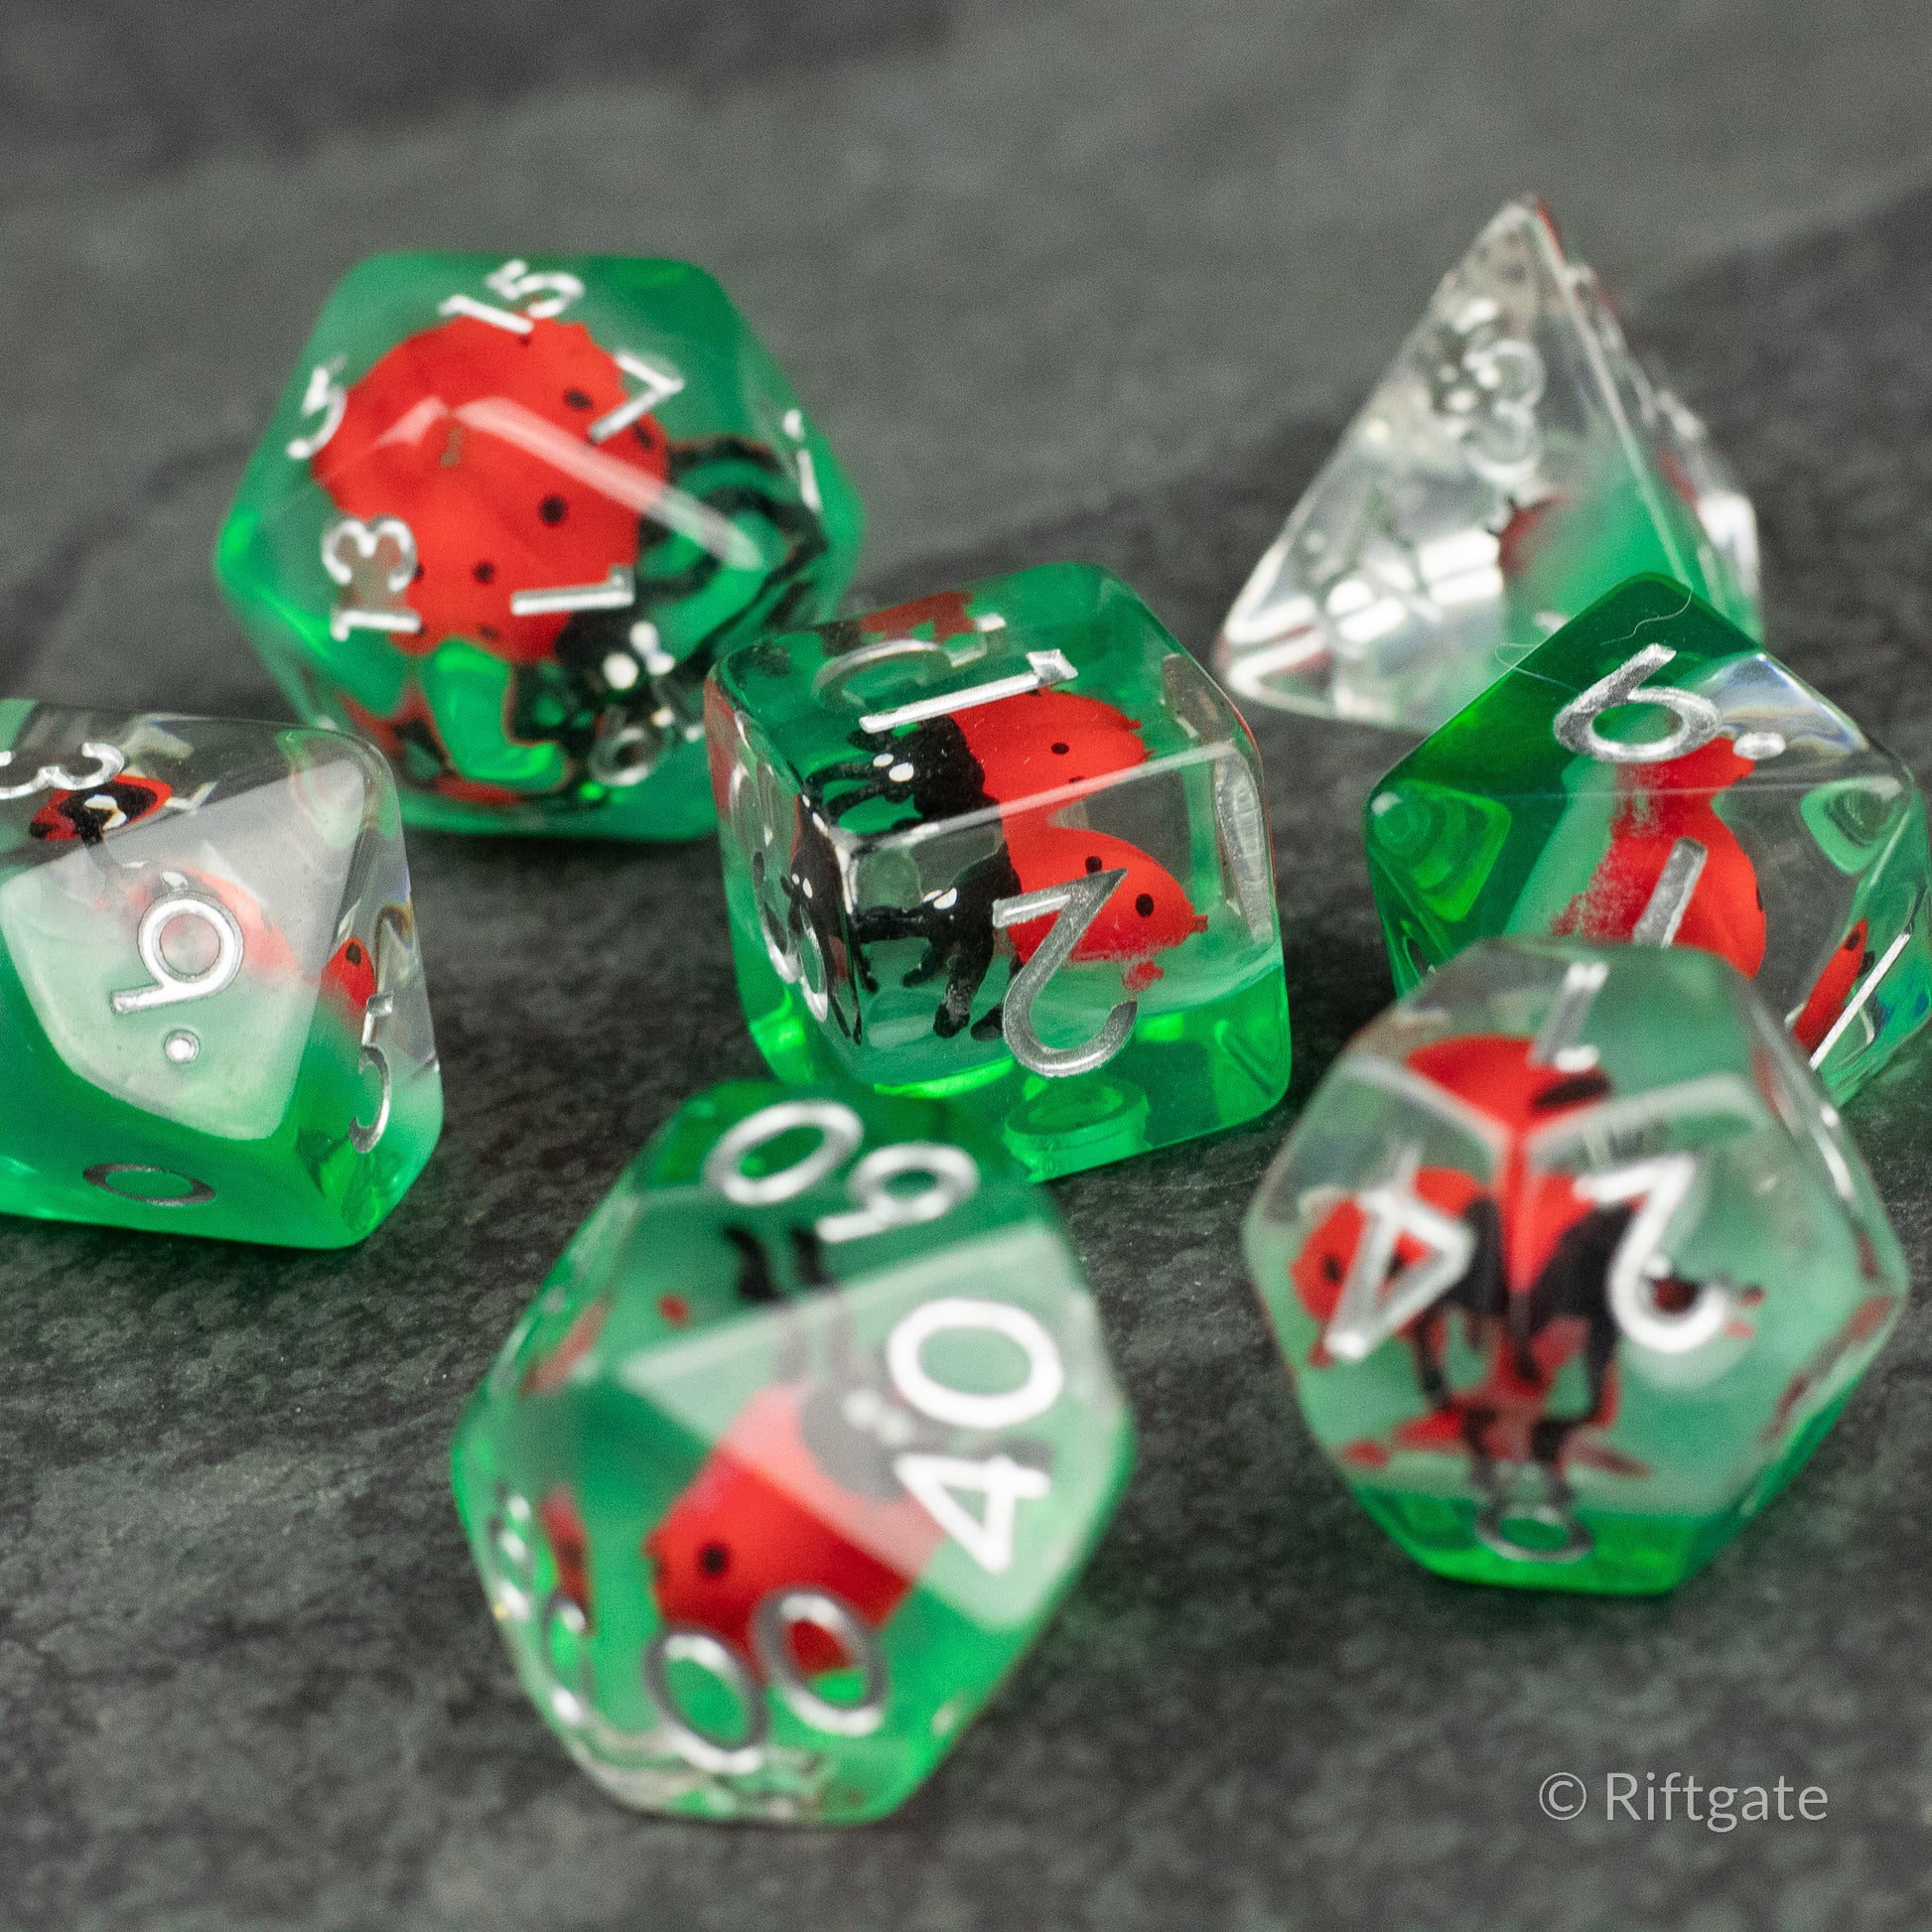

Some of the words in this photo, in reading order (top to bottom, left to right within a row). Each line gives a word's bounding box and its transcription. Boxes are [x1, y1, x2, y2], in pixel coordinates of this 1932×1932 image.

[439, 259, 585, 333] 15
[322, 513, 421, 641] 13
[859, 649, 1078, 734] 1
[993, 868, 1138, 1077] 2
[1573, 1152, 1735, 1354] 2
